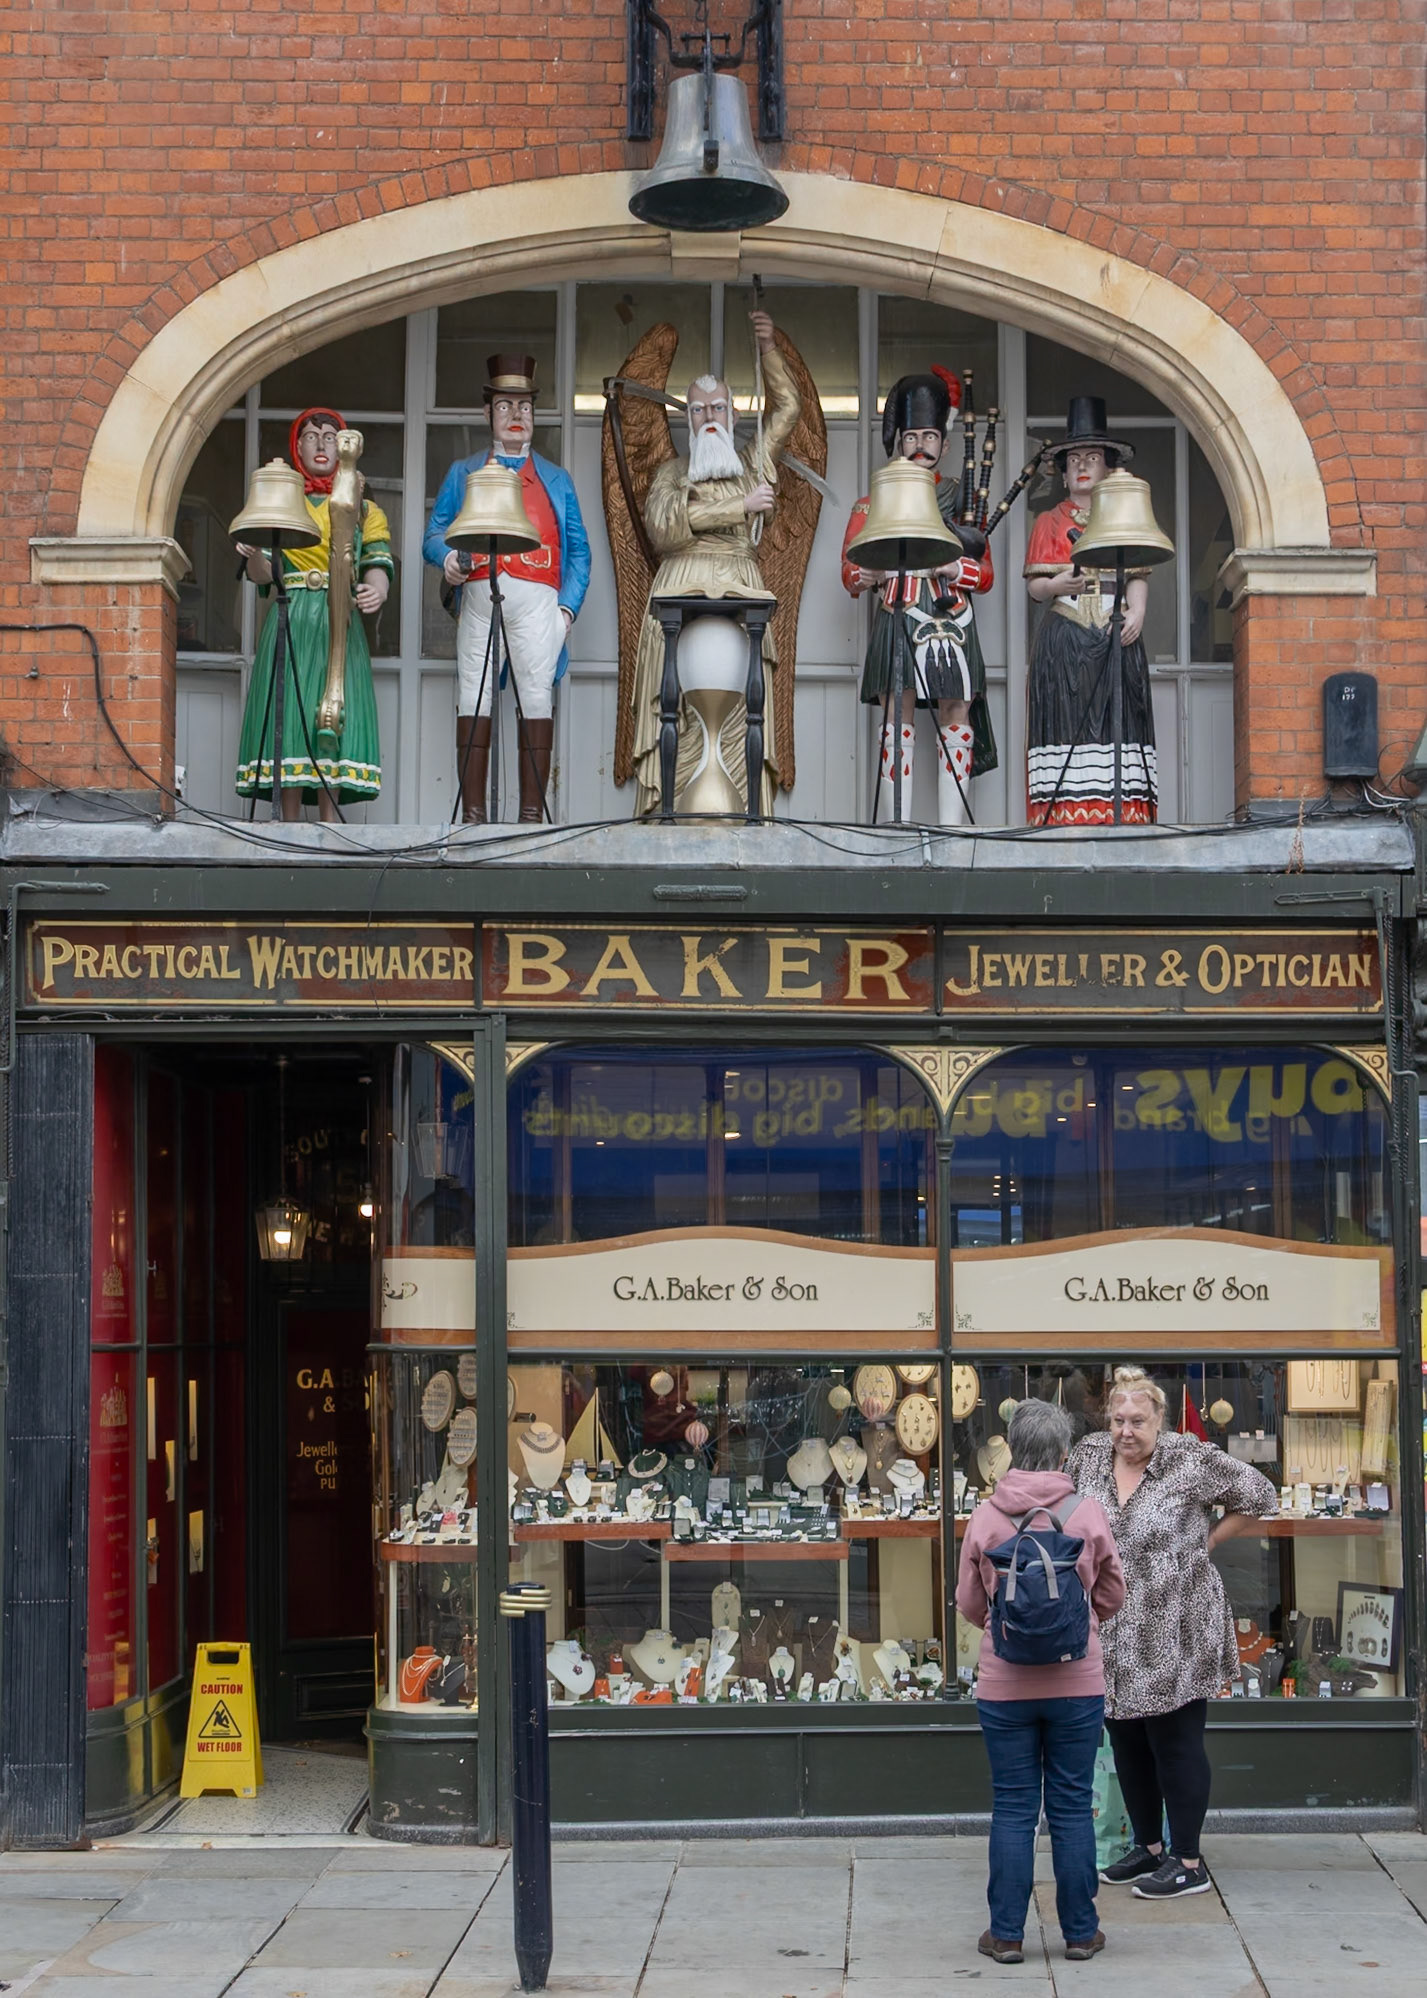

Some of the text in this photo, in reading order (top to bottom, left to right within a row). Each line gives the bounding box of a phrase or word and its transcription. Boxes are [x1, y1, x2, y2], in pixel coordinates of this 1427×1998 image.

[42, 935, 474, 990] PRACTICAL WATCHMAKER
[504, 934, 910, 999] BAKER
[1155, 949, 1191, 987] &
[1198, 944, 1373, 995] OPTICIAN
[613, 1275, 819, 1301] G.A.Baker & Son
[1064, 1276, 1270, 1302] G.A.Baker & Son
[323, 1395, 336, 1413] &
[296, 1441, 338, 1457] Jewell
[315, 1459, 338, 1475] Gol
[200, 1683, 243, 1695] CAUTION
[197, 1741, 242, 1752] WET FLOOR
